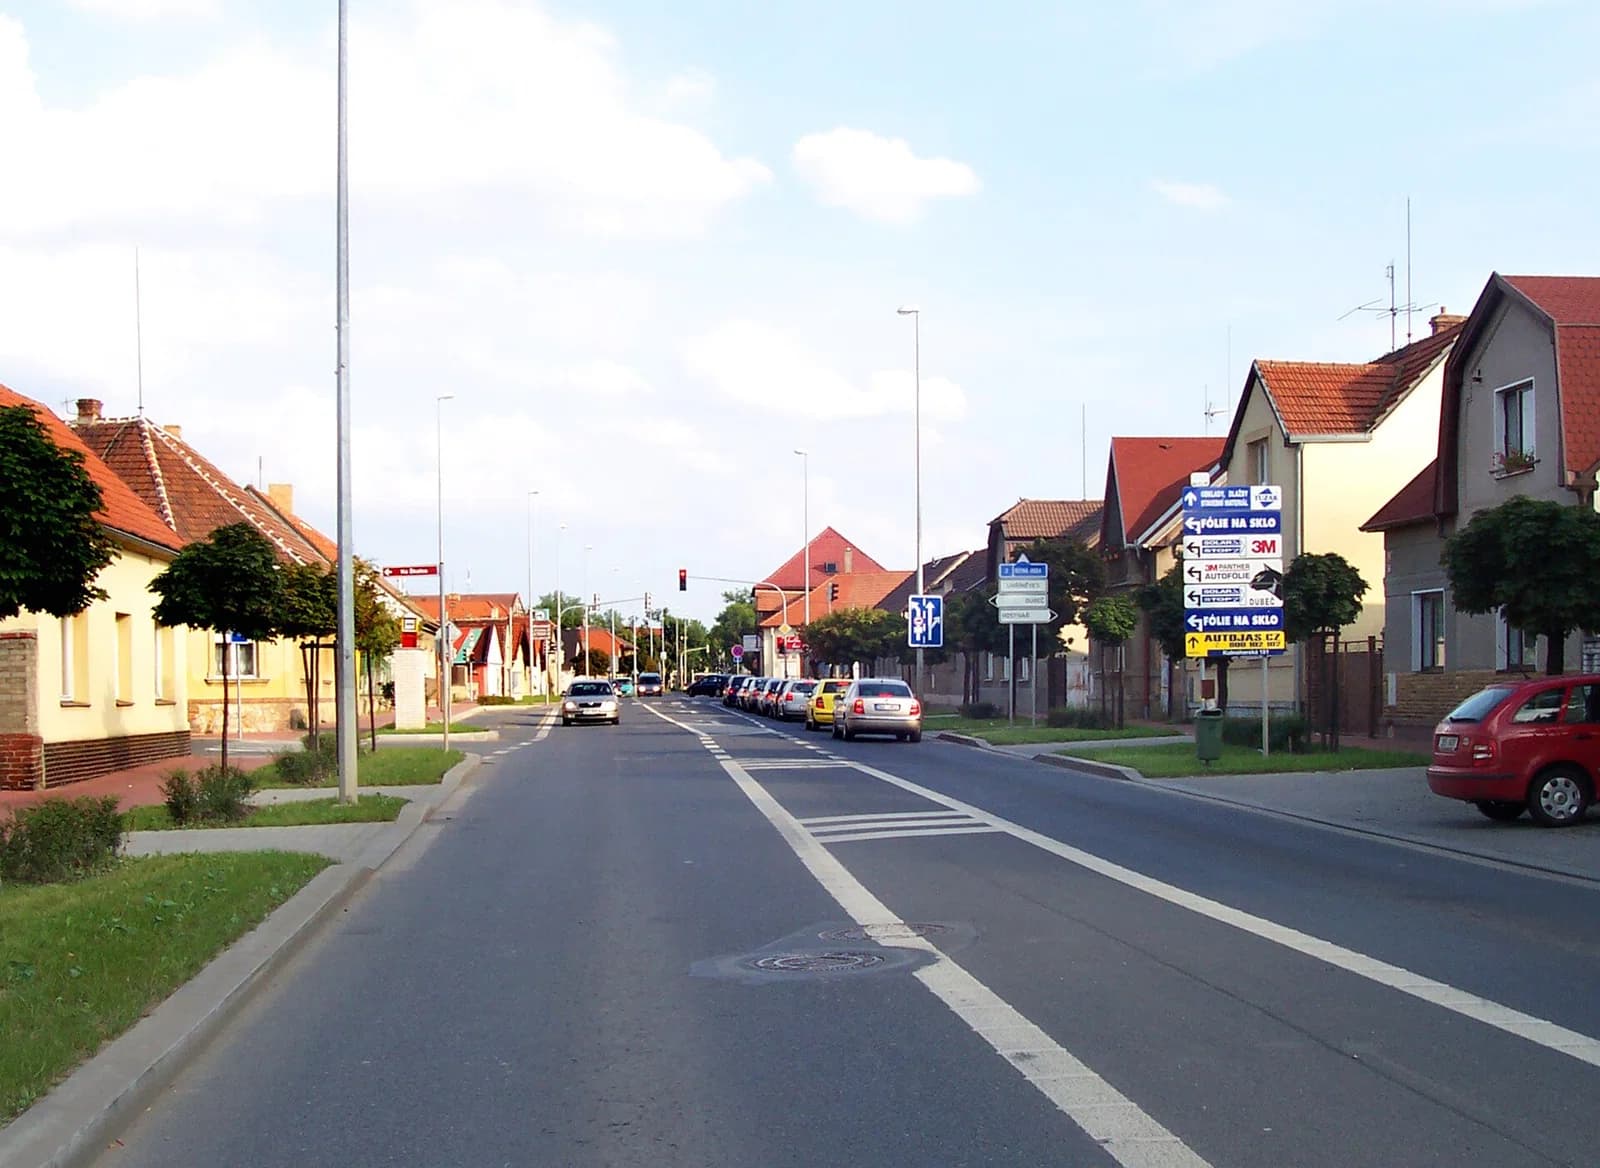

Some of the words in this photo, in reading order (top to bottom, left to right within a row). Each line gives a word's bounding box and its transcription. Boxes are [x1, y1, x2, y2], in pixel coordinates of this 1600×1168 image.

[1201, 516, 1229, 528] FÓLIE
[1231, 518, 1247, 528] NA
[1249, 518, 1276, 528] SKLO
[1251, 540, 1276, 553] 3M
[1205, 572, 1250, 580] AUTOFOLIE
[1249, 597, 1275, 606] DUBEČ
[1203, 613, 1231, 626] FÓLIE
[1233, 616, 1249, 626] NA
[1251, 615, 1279, 625] SKLO
